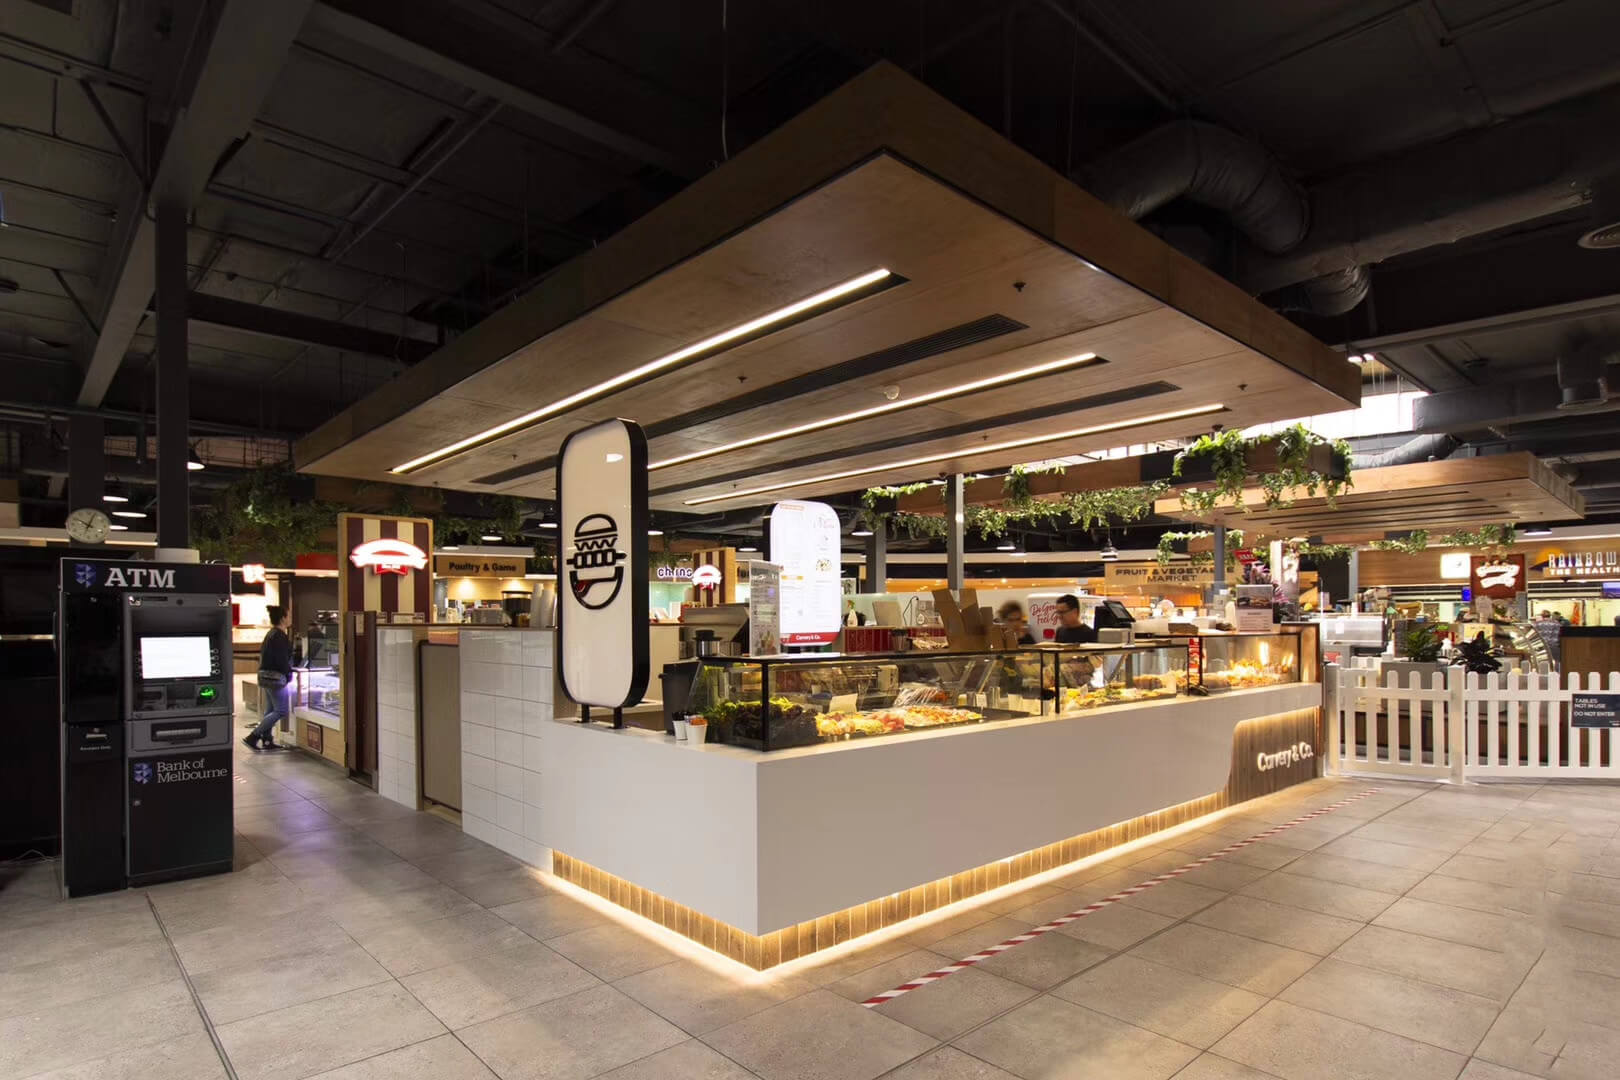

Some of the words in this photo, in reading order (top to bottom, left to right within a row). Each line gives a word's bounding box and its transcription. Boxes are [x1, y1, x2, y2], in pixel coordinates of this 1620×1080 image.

[448, 562, 480, 573] Poultry
[483, 563, 490, 571] &
[492, 563, 516, 571] Game
[1548, 551, 1617, 568] RAINBOW
[104, 567, 176, 588] ATM
[1147, 575, 1198, 583] MARKET
[1549, 567, 1571, 576] THE
[1576, 566, 1620, 575] HEALTH
[157, 760, 191, 773] Bank
[192, 758, 206, 769] of
[1257, 750, 1292, 772] Carvery
[157, 767, 228, 784] Melbourne
